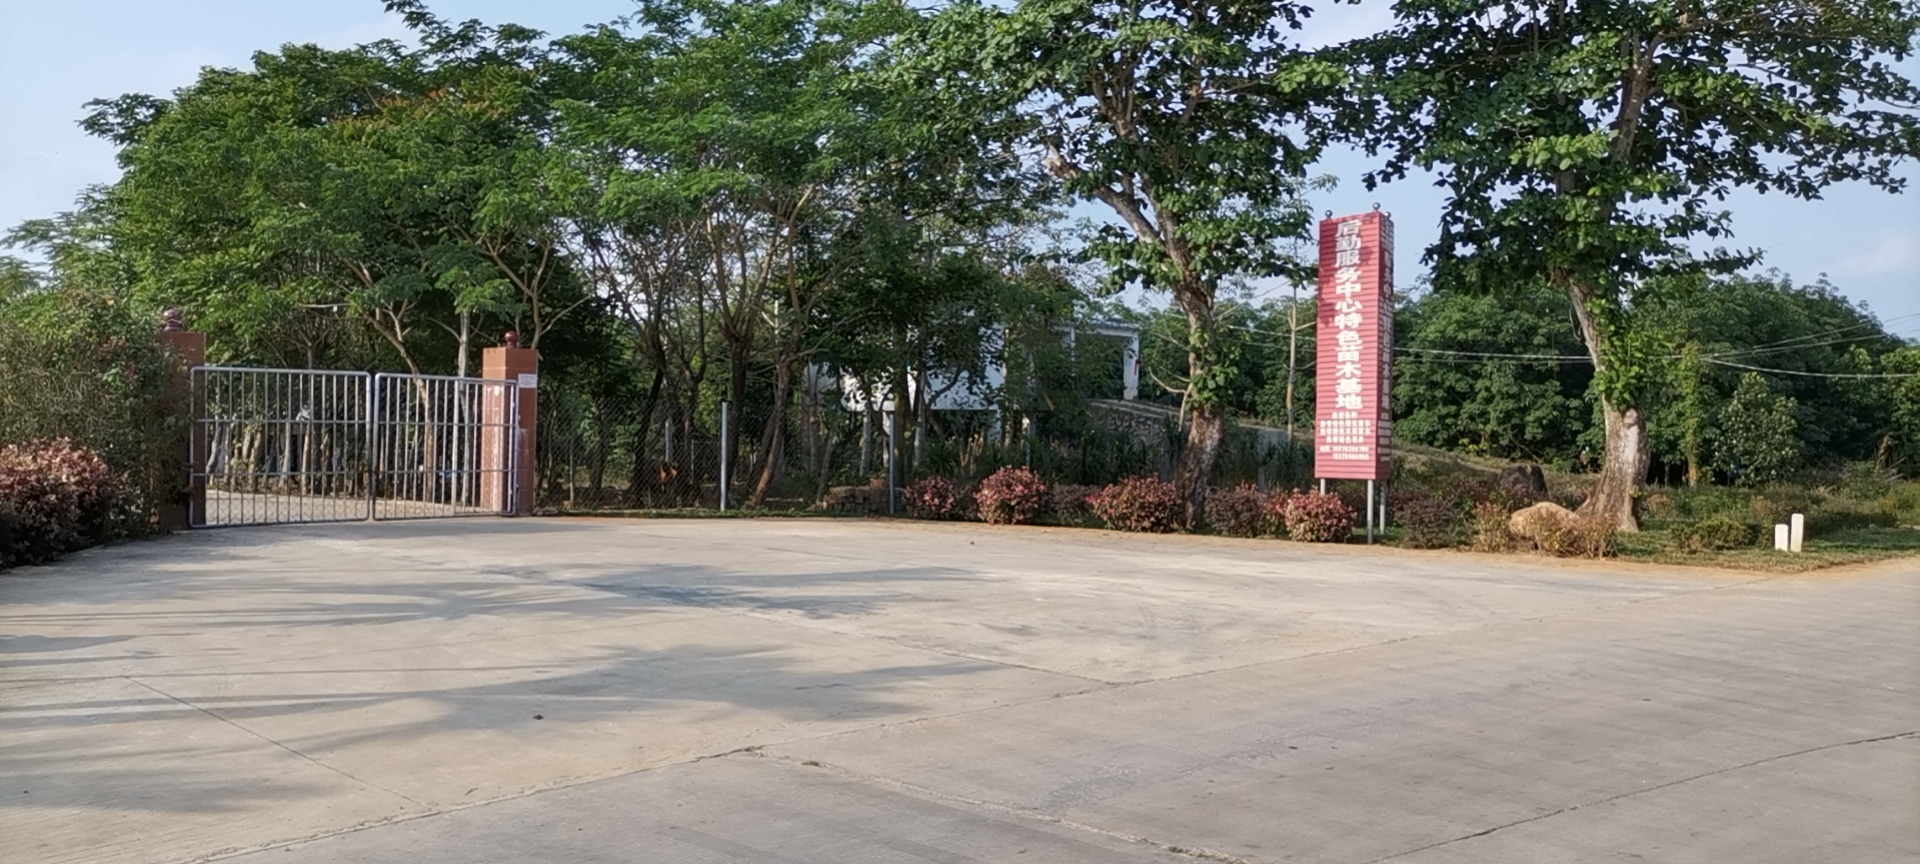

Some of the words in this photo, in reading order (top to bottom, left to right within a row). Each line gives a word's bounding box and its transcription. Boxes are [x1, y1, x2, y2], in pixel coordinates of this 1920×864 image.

[1335, 220, 1363, 409] 后勤服务中心特色苗木基地
